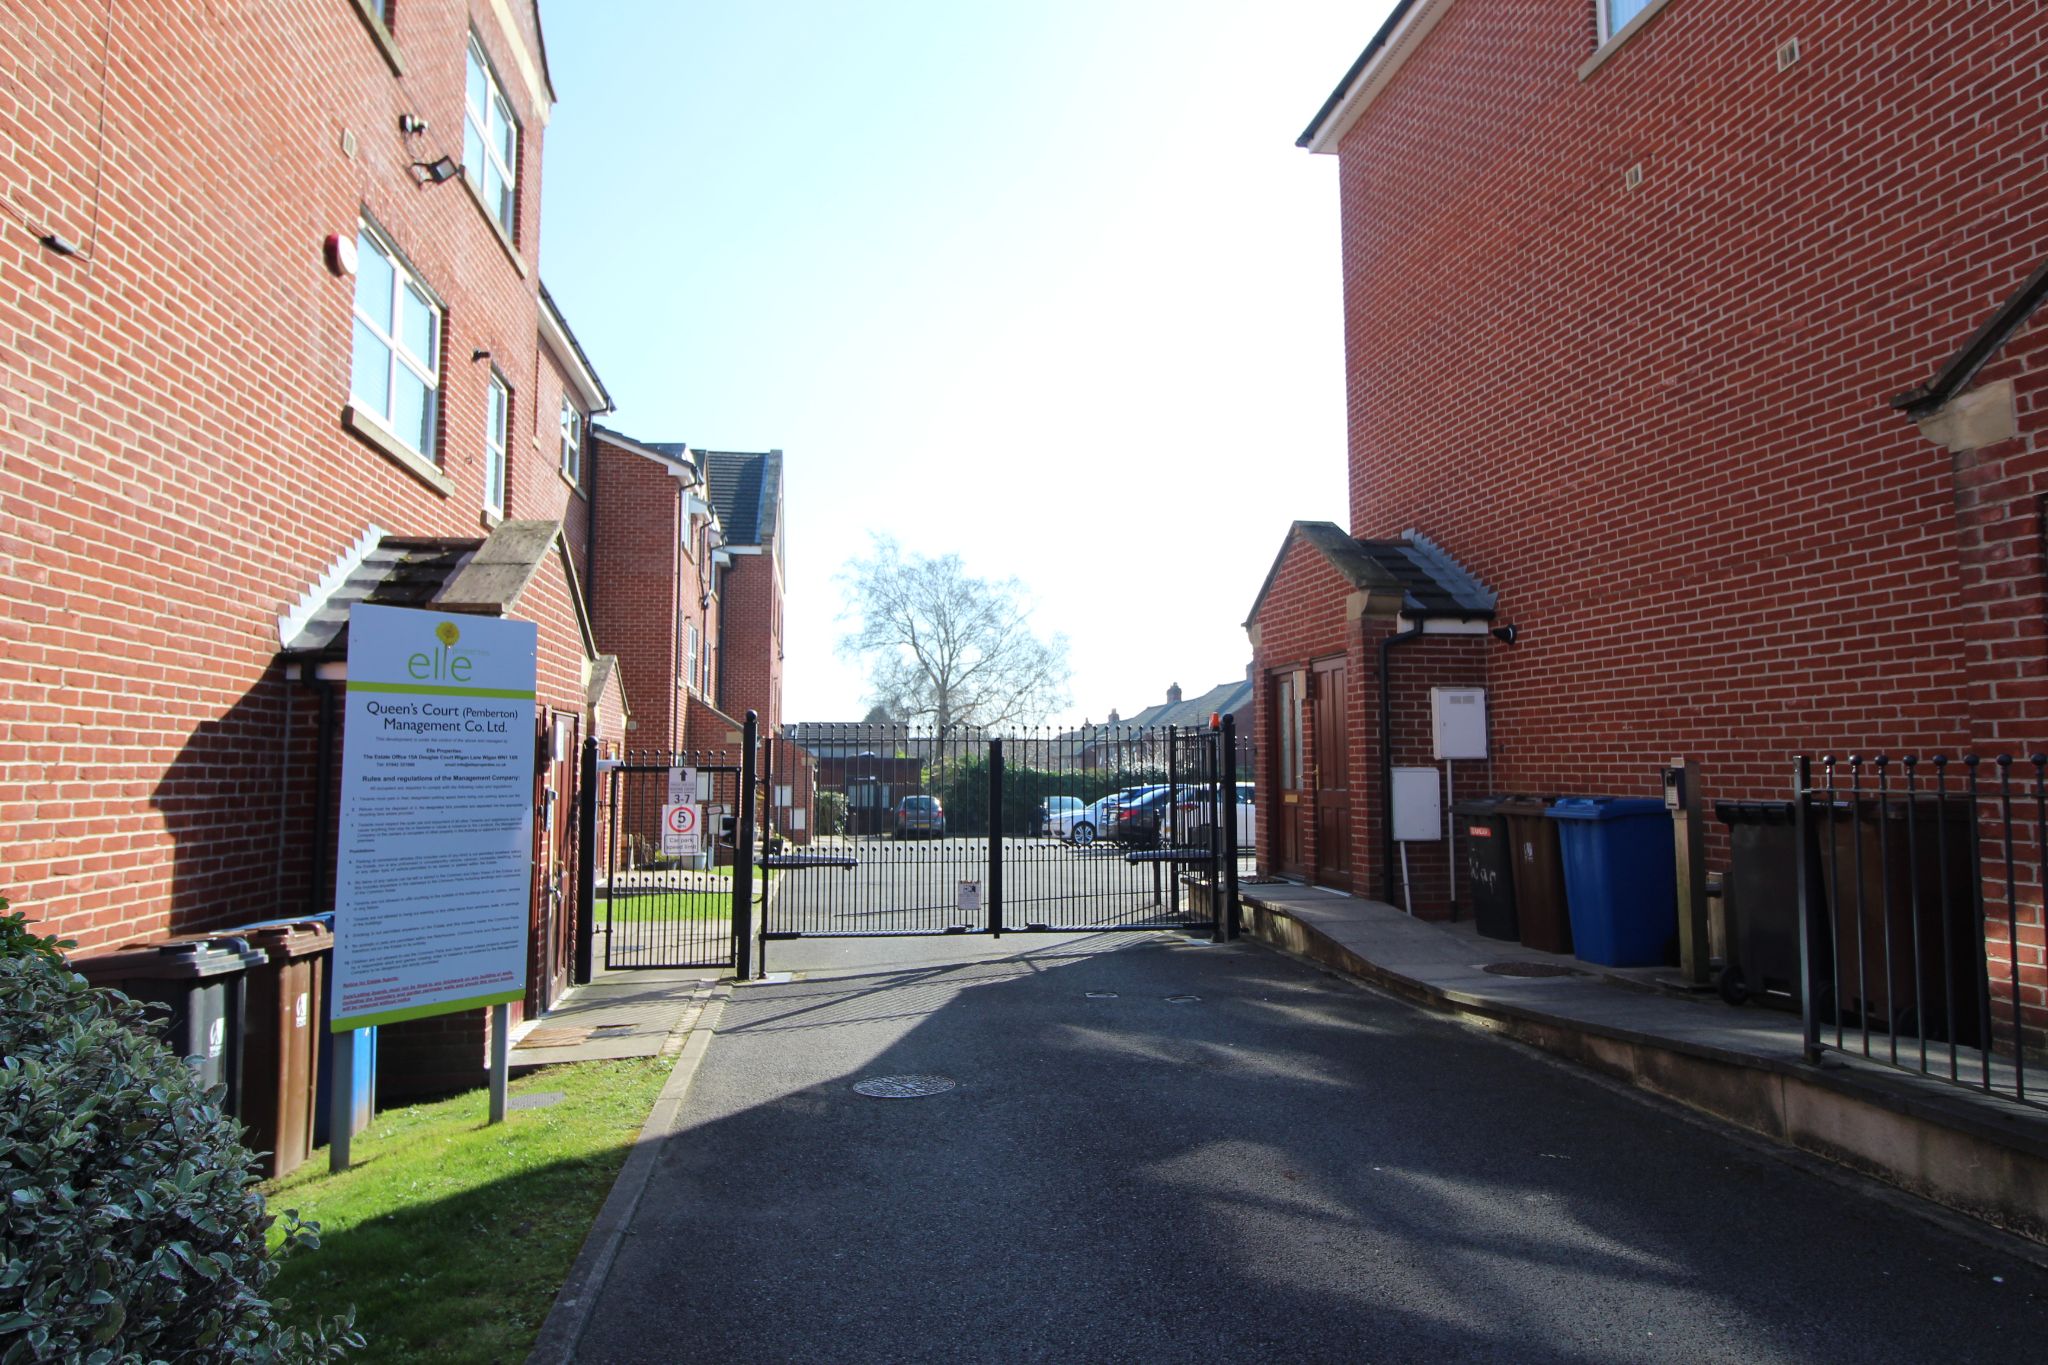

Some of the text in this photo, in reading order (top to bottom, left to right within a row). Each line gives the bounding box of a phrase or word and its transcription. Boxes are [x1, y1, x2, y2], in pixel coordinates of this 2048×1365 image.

[367, 701, 518, 720] Queen's Court (Pemberton)
[384, 717, 508, 734] Management Co. Ltd.
[397, 775, 433, 783] regulations
[674, 794, 690, 804] 3-7
[678, 811, 686, 824] 5
